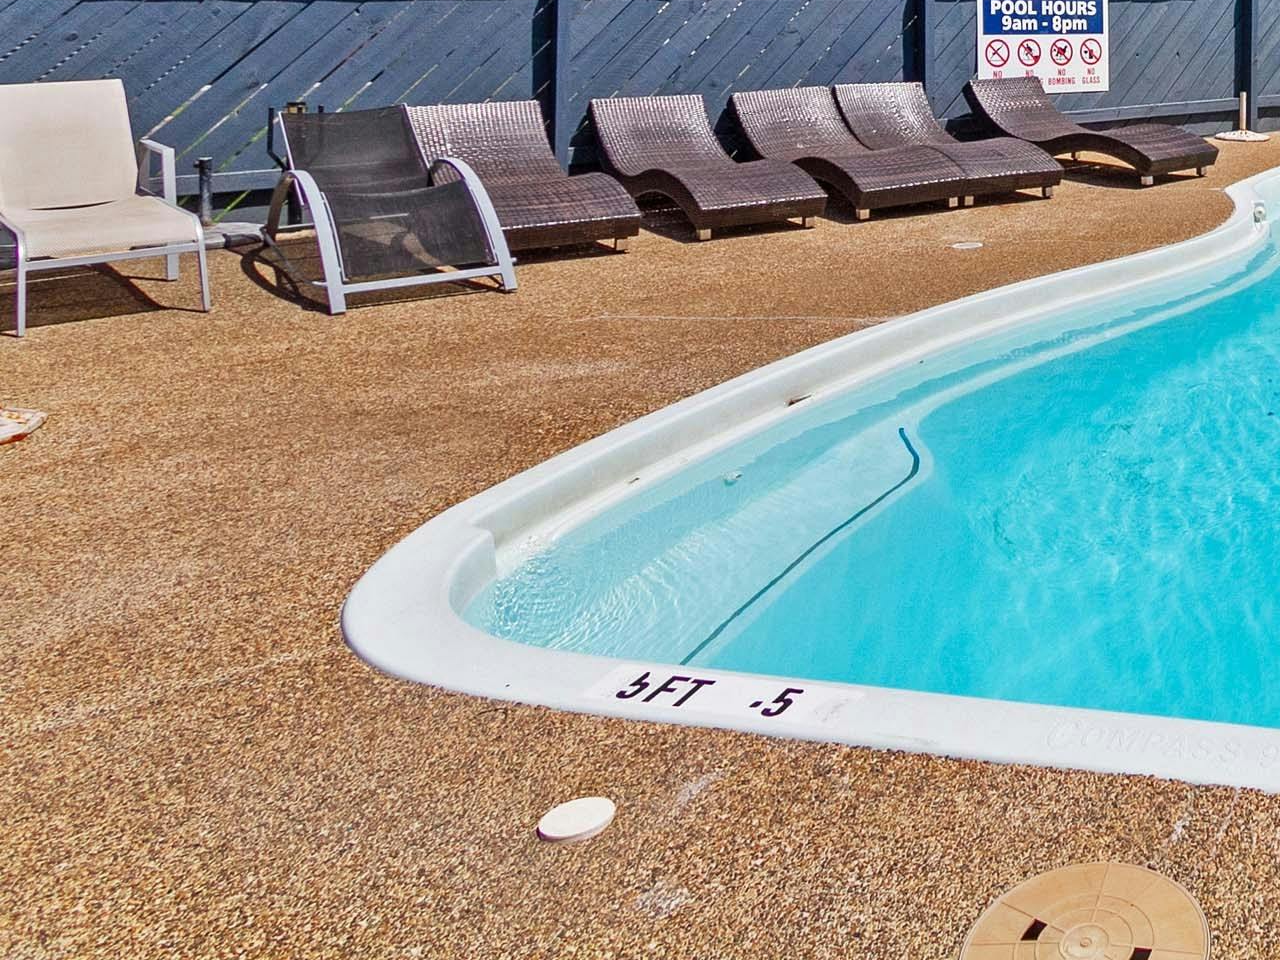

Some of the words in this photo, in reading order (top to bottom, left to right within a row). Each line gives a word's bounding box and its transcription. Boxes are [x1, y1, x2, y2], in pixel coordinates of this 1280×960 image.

[990, 0, 1037, 15] POOL
[1041, 0, 1097, 15] HOURS
[1001, 15, 1038, 31] 9am
[1052, 15, 1088, 34] 8pm
[993, 71, 1003, 79] NO
[1057, 68, 1066, 76] NO
[1087, 67, 1096, 76] NO
[1048, 76, 1076, 86] BOMBING
[1081, 75, 1101, 85] GLASS
